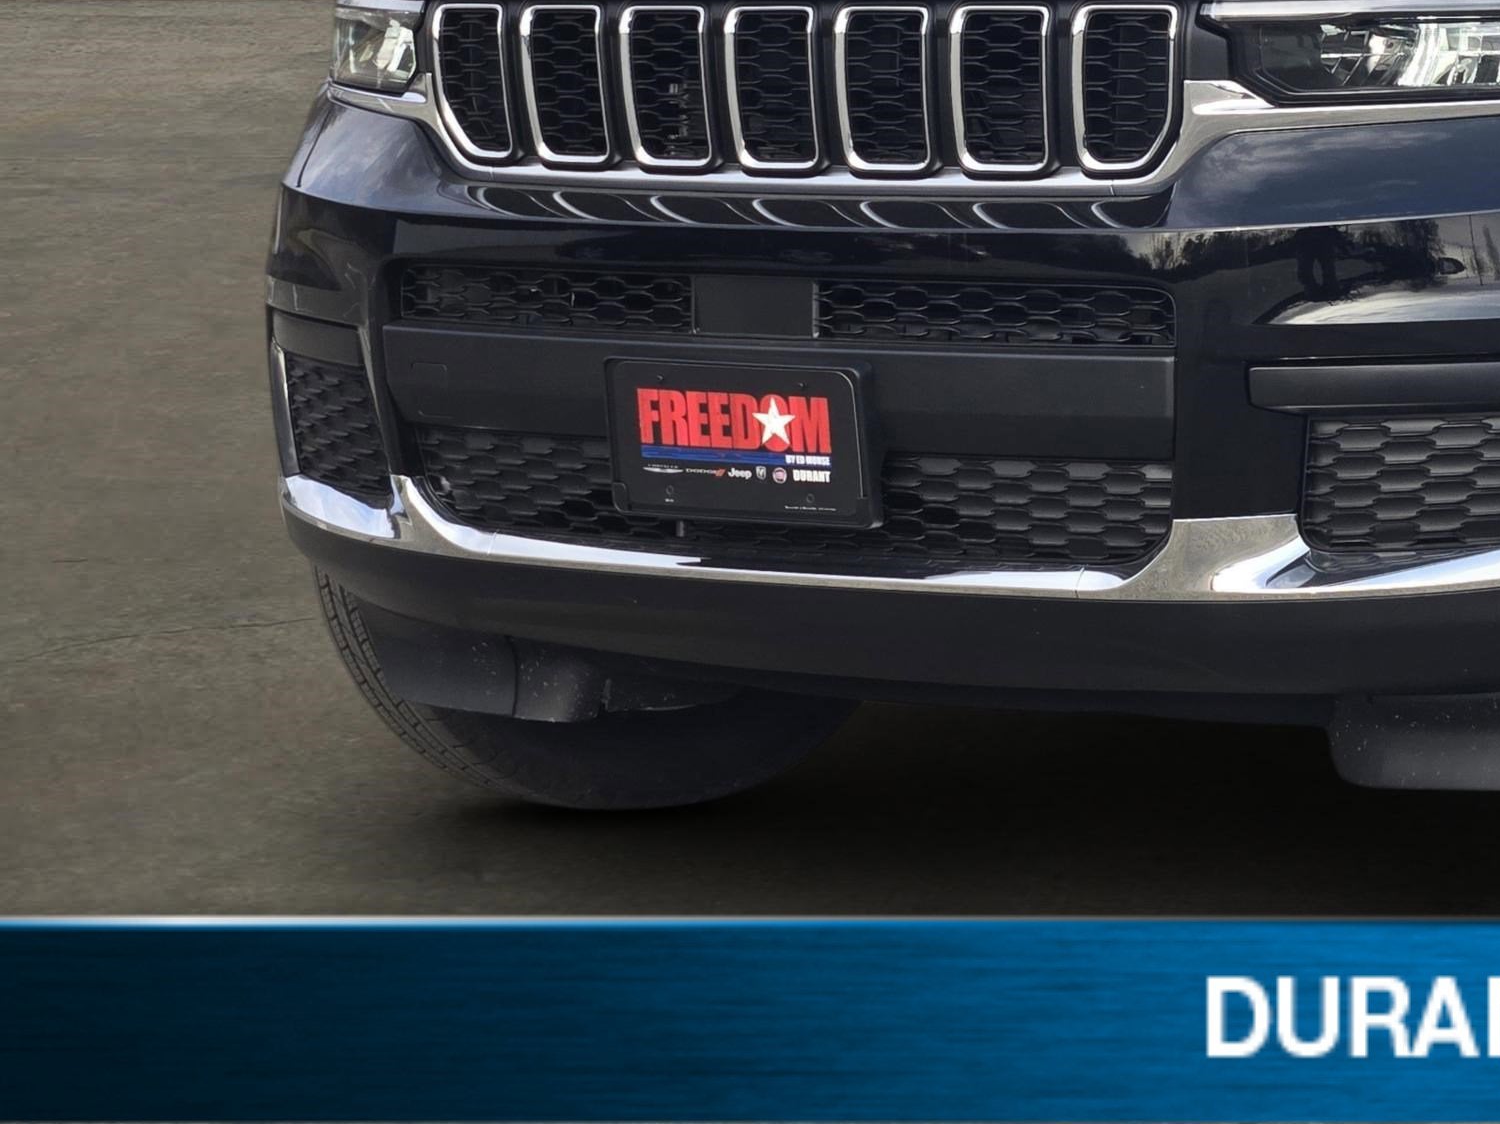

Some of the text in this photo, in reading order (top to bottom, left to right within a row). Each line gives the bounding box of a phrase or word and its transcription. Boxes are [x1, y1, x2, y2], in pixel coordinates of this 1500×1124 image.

[636, 387, 832, 454] FREEDOM
[727, 466, 753, 480] Jeep
[792, 468, 832, 483] DURANT
